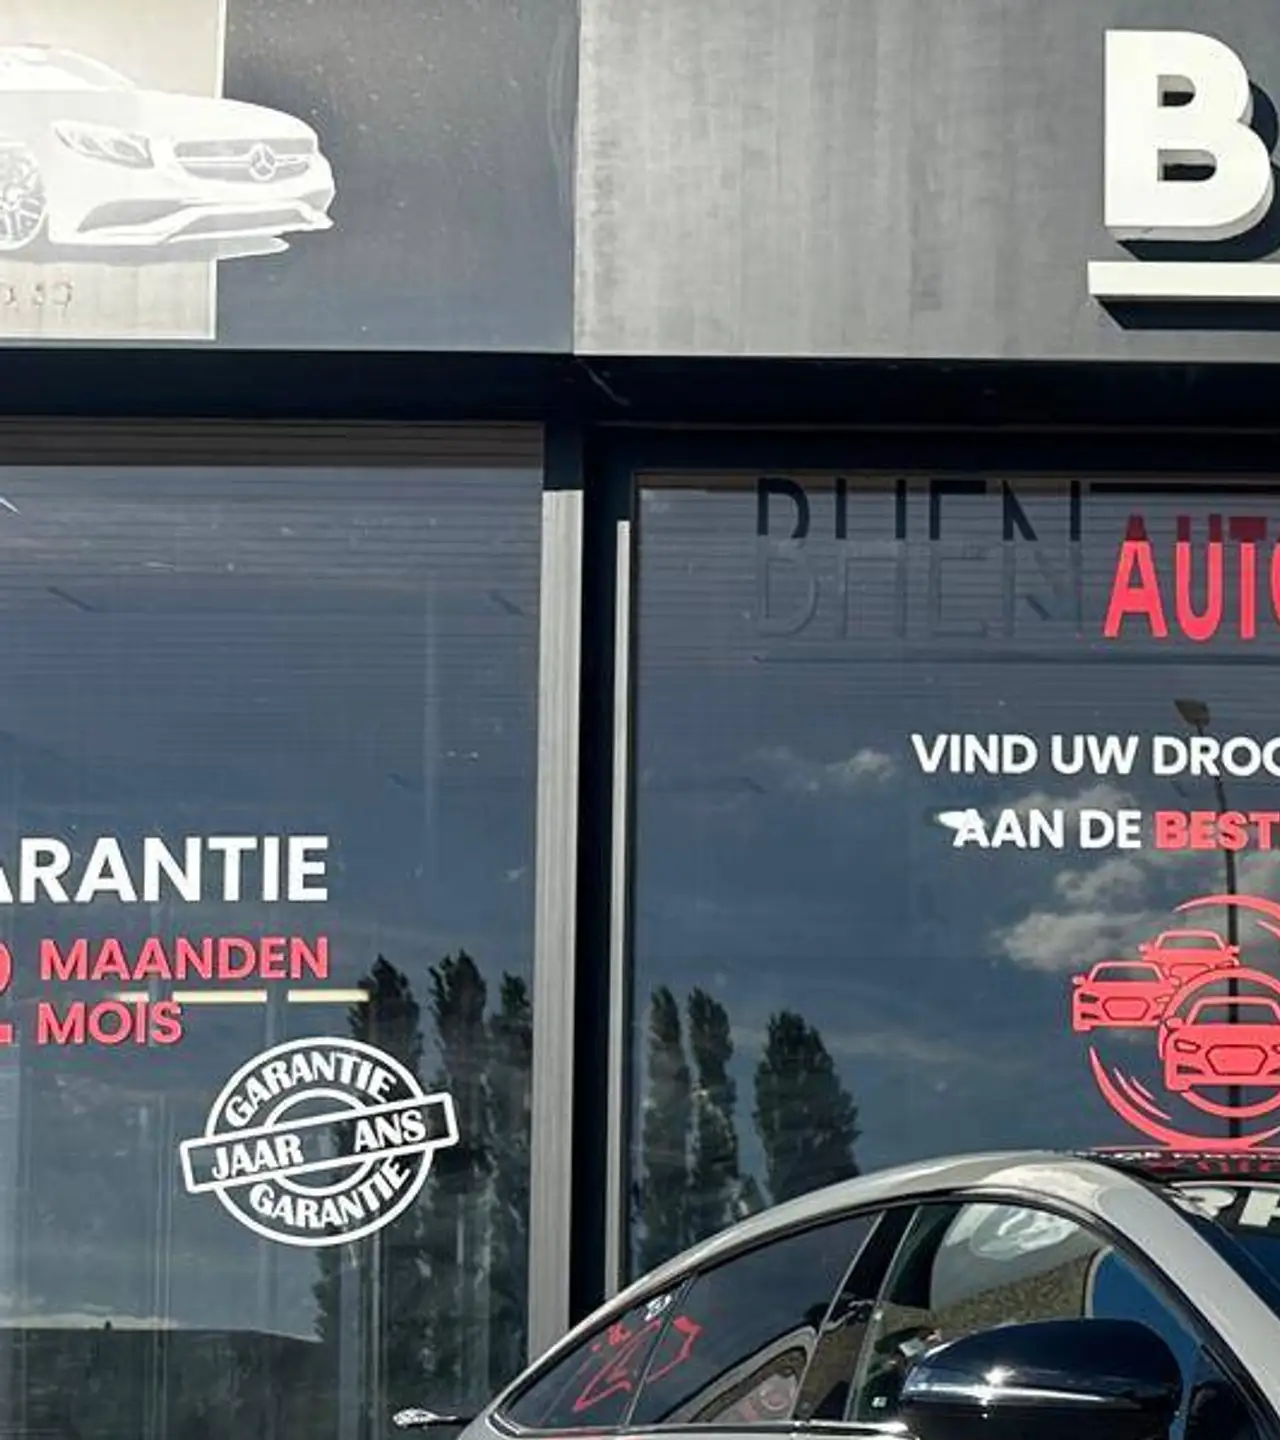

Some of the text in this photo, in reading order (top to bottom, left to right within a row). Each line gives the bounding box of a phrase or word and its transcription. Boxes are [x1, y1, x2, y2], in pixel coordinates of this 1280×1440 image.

[910, 733, 1039, 775] VIND
[1050, 734, 1140, 775] UW
[952, 807, 1065, 849] AAN
[1078, 808, 1143, 850] DE
[0, 836, 329, 903] RANTIE
[39, 935, 329, 982] MAANDEN
[35, 1000, 183, 1044] MOIS
[225, 1051, 397, 1127] GARANTIE
[212, 1108, 427, 1180] JAAR ANS
[249, 1155, 411, 1229] GARANTIE
